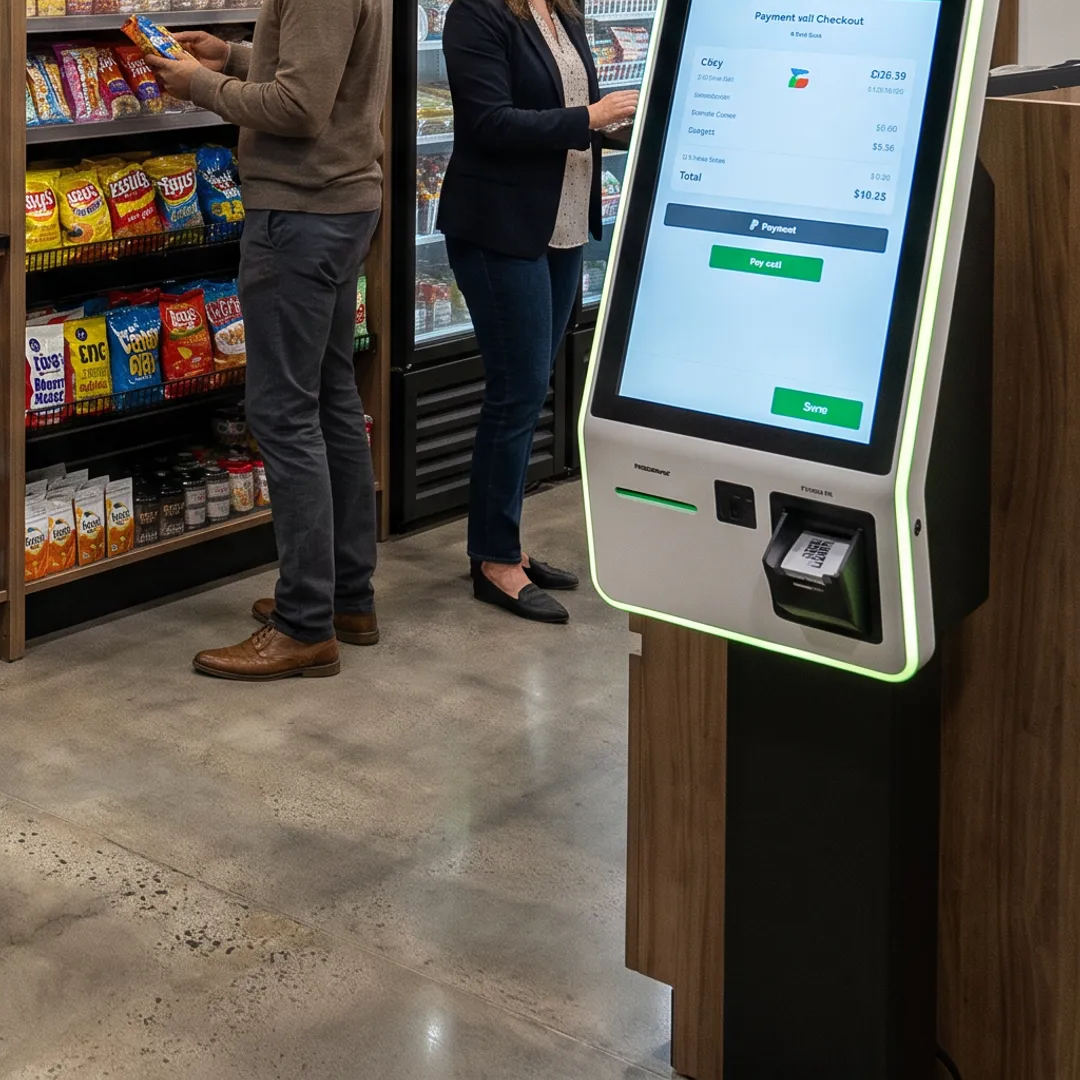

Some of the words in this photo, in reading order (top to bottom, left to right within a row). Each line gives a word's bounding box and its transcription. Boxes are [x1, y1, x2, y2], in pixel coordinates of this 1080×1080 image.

[755, 11, 796, 24] Payment
[816, 14, 864, 26] Checkout
[680, 170, 702, 182] Total
[854, 189, 887, 201] $10.25
